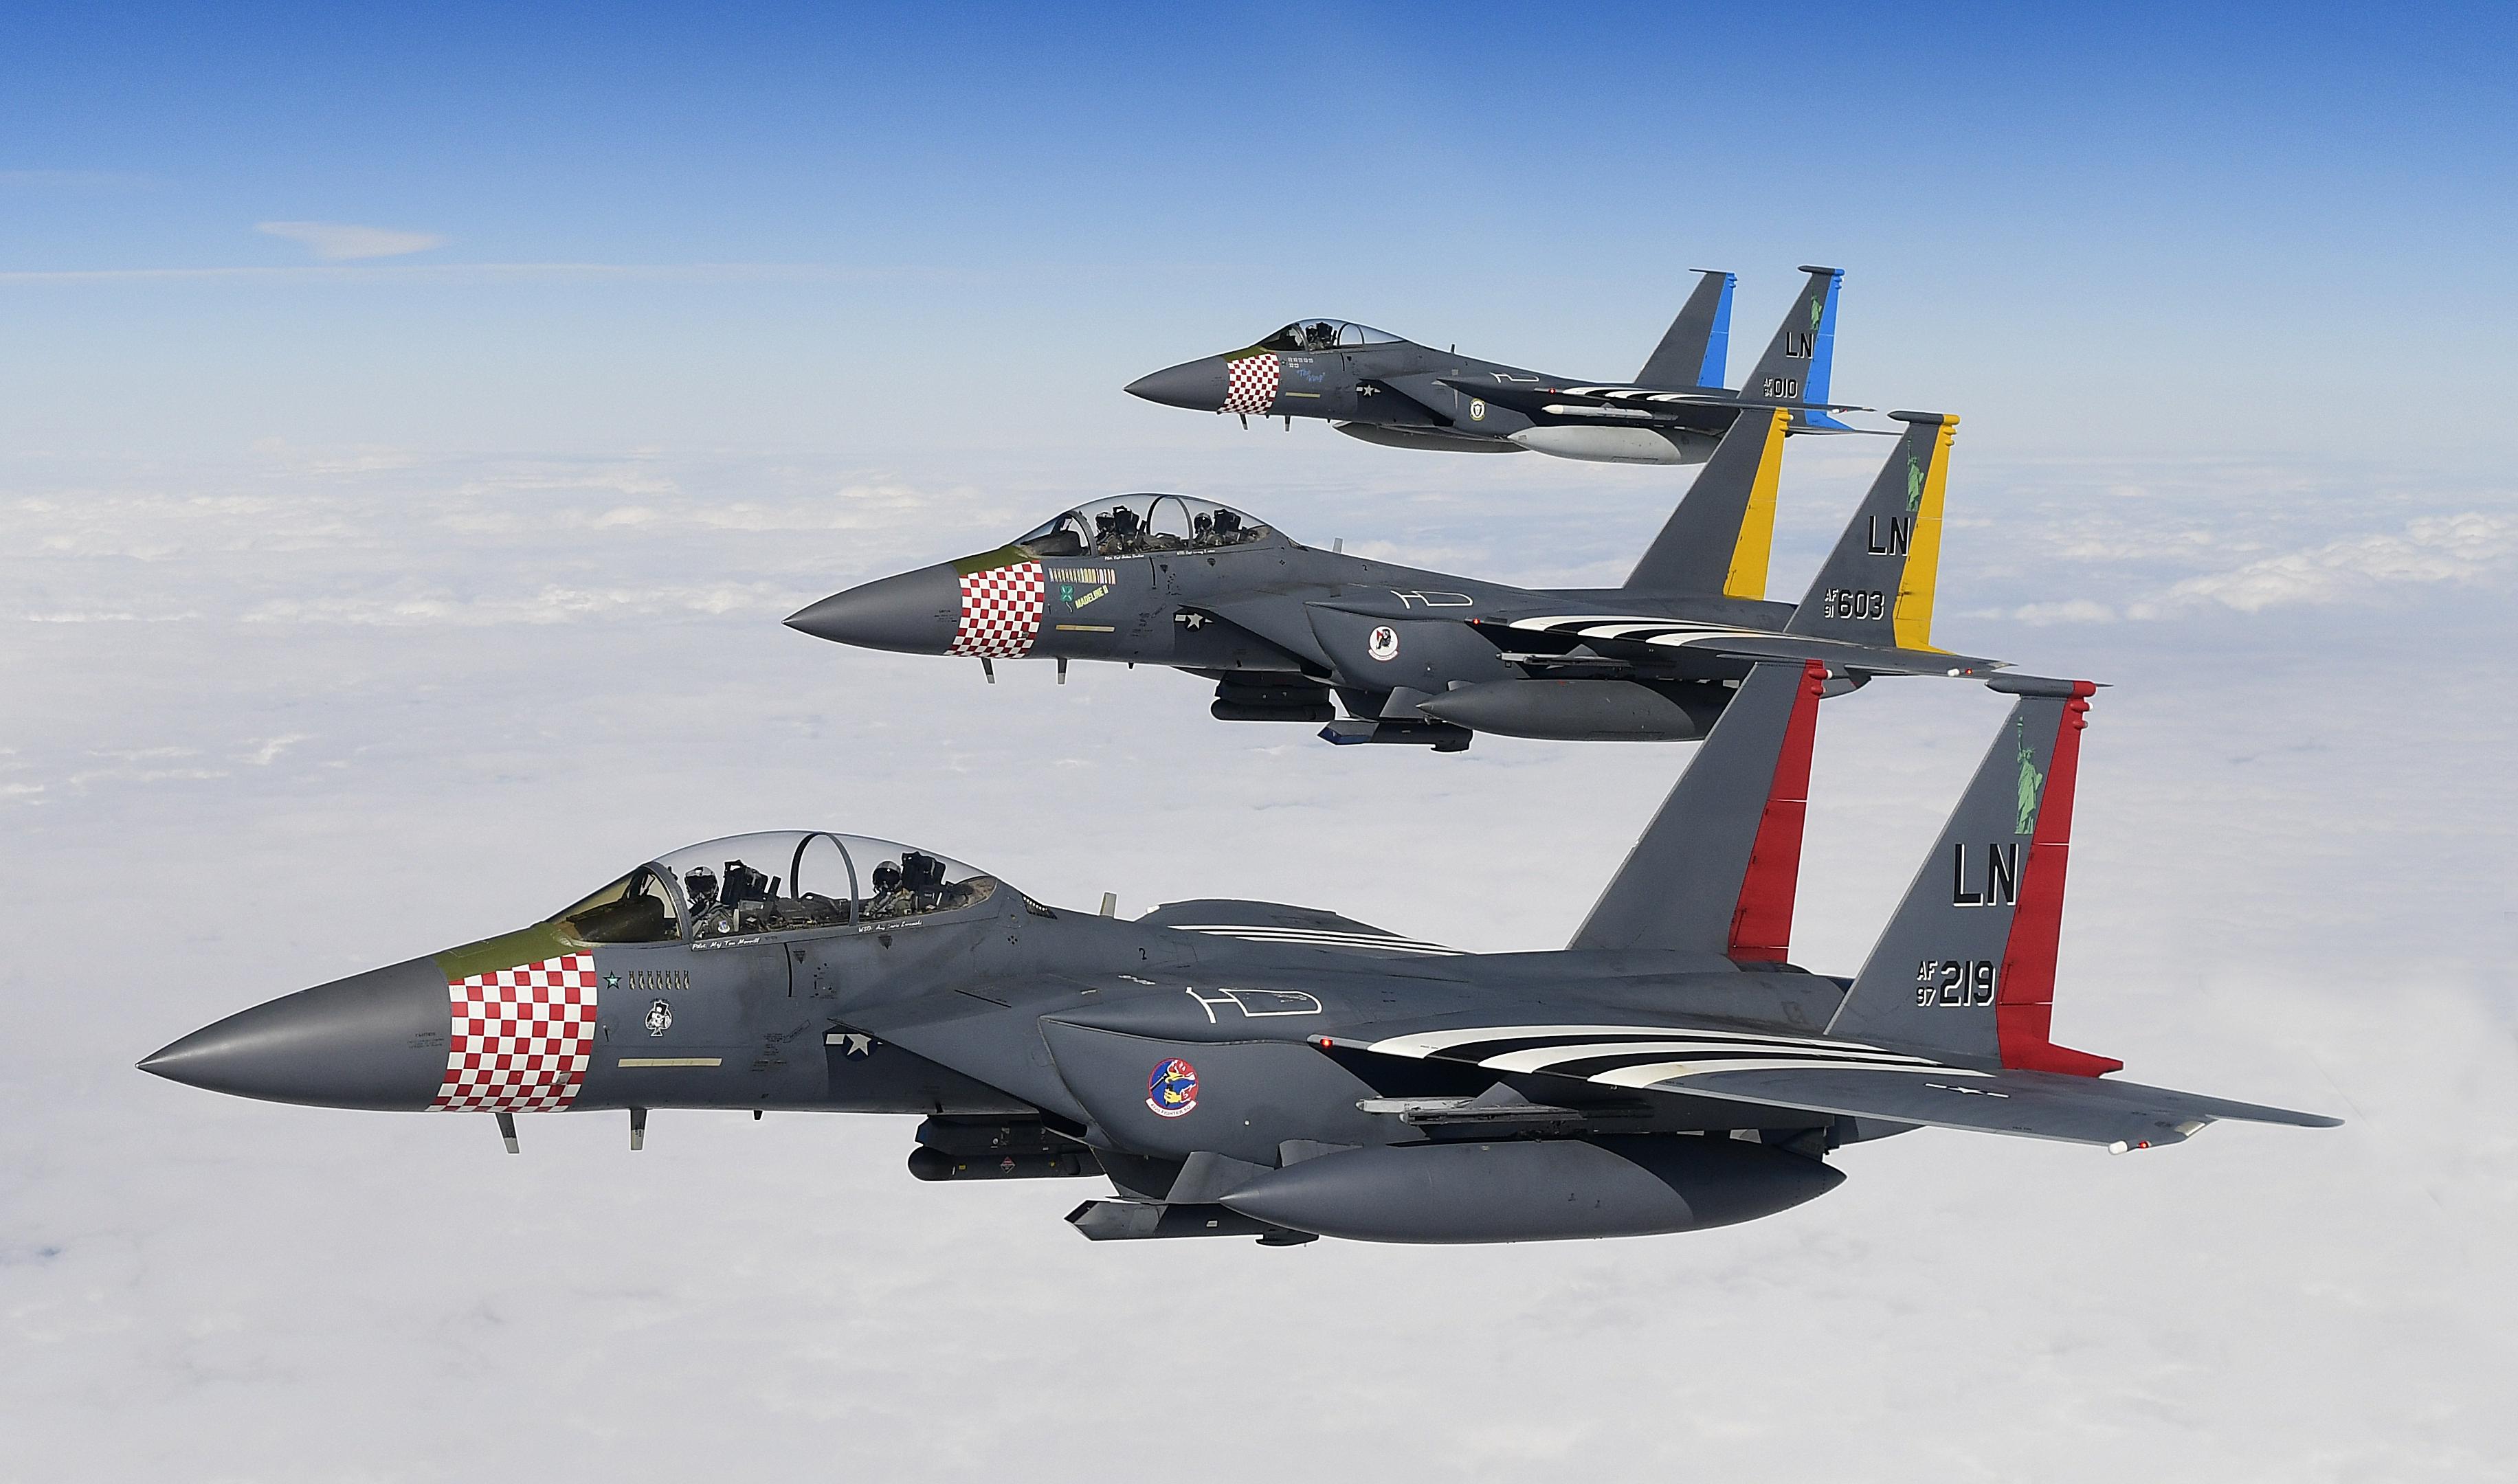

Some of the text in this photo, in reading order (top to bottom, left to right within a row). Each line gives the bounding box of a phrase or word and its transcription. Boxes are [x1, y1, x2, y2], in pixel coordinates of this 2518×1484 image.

[1786, 332, 1814, 359] LN
[1774, 379, 1798, 398] 010
[1868, 515, 1910, 556] LN
[1075, 587, 1104, 609] MADELINE
[1825, 588, 1839, 602] AF
[1838, 589, 1885, 620] 603
[1954, 843, 2019, 907] LN
[1138, 947, 1148, 960] 2
[1916, 960, 1939, 981] AF
[1939, 960, 1996, 1007] 219
[1915, 986, 1937, 1007] 97
